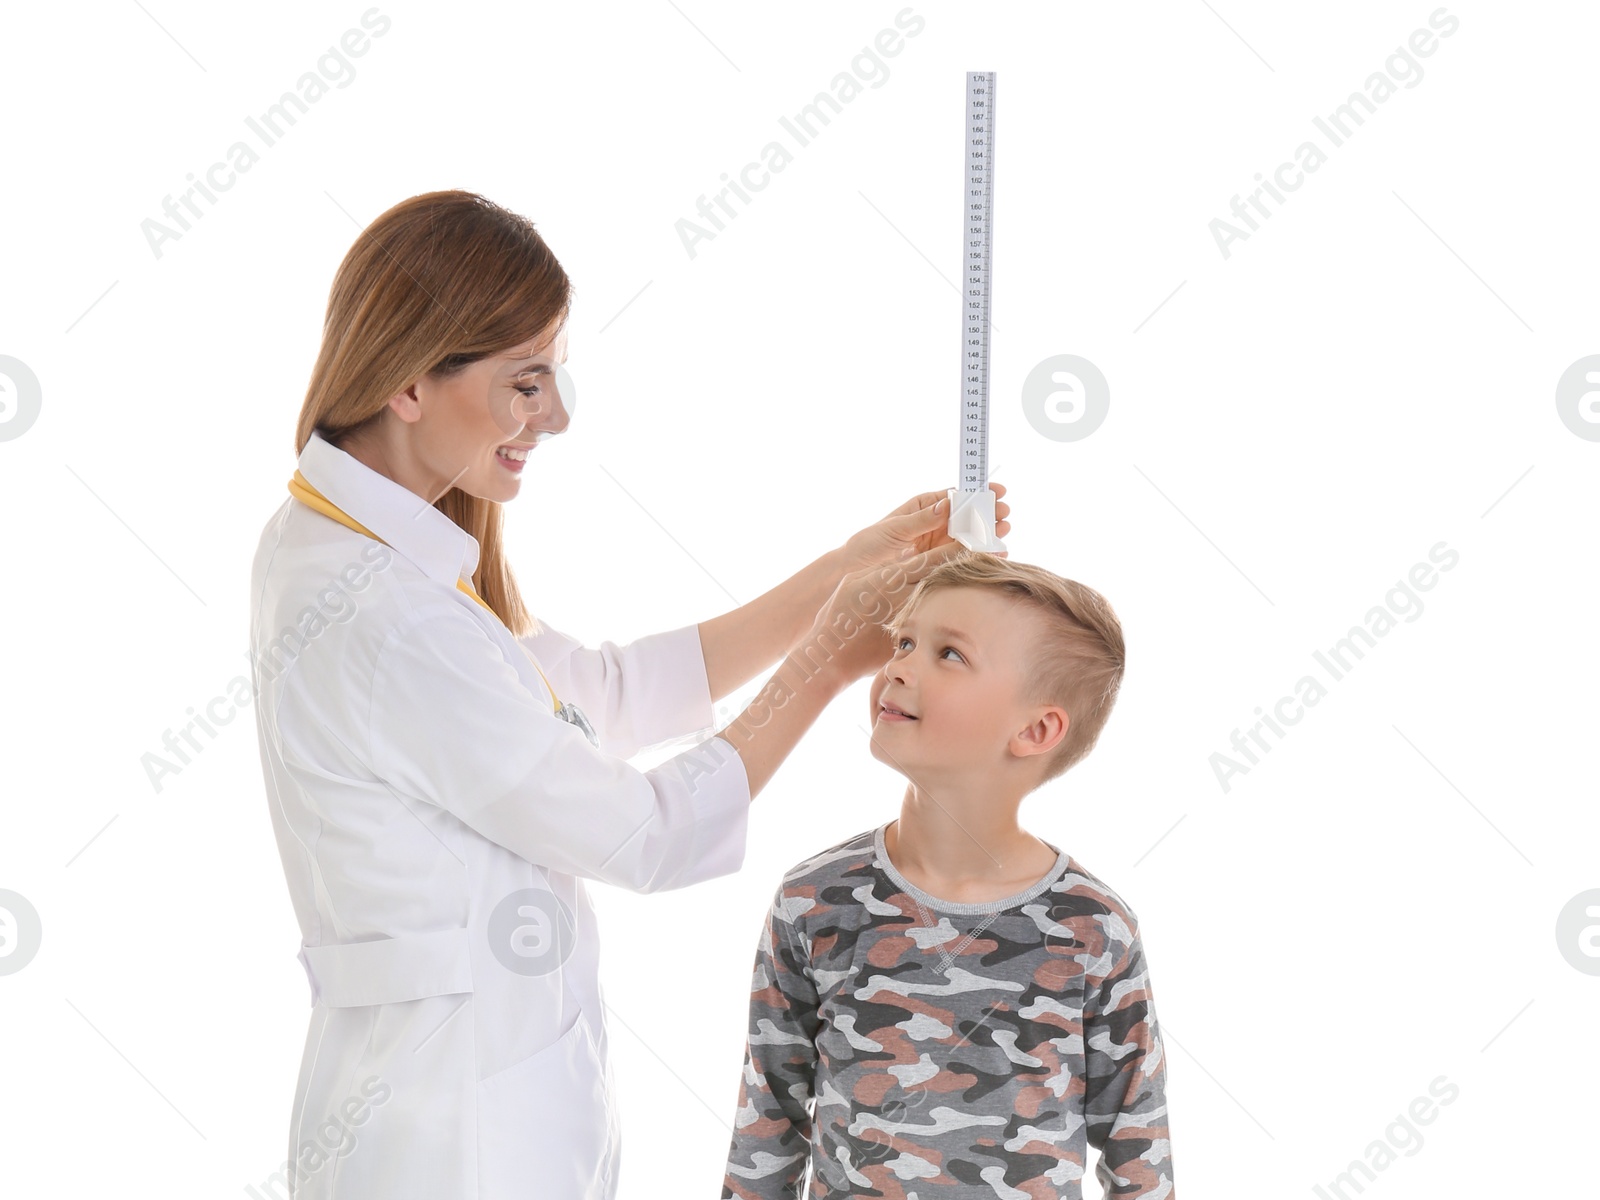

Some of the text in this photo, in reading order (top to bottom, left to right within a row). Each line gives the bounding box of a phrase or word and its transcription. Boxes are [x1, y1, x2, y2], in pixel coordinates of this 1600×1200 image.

[972, 75, 986, 83] 1.70
[972, 100, 985, 108] 1.68
[972, 113, 984, 121] 1.67
[971, 138, 984, 146] 1.65
[971, 151, 984, 159] 1.64
[970, 189, 982, 197] 1.61
[970, 203, 983, 211] 1.60
[970, 214, 983, 222] 1.59
[969, 240, 982, 248] 1.57
[969, 264, 982, 272] 1.55
[968, 289, 981, 297] 1.53
[968, 301, 981, 309] 1.52
[968, 326, 981, 334] 1.50
[967, 351, 980, 359] 1.48
[967, 363, 980, 371] 1.47
[966, 388, 979, 396] 1.45
[965, 425, 978, 433] 1.42
[965, 437, 977, 445] 1.41
[965, 449, 978, 457] 1.40
[965, 463, 978, 471] 1.39
[965, 475, 977, 483] 1.38
